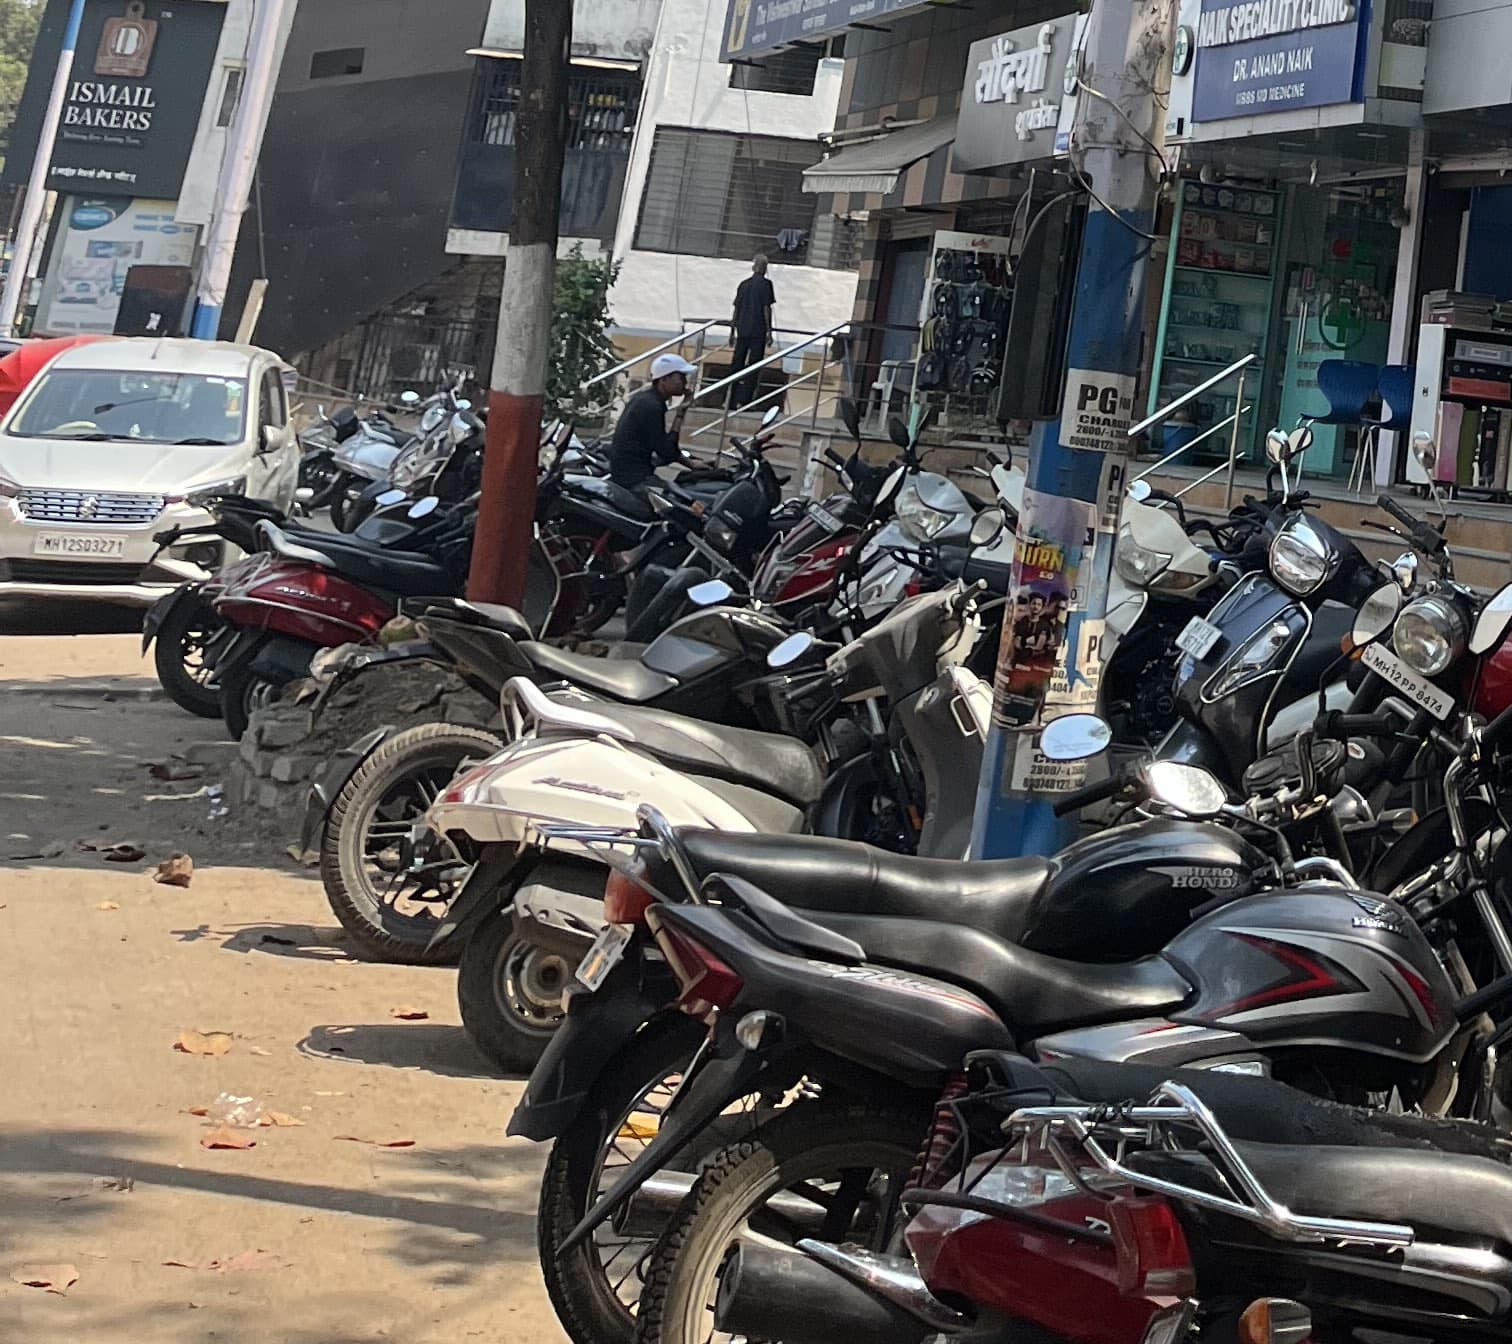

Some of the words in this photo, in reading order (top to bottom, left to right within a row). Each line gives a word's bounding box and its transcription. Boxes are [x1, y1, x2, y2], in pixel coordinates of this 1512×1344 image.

[1199, 9, 1228, 48] NAIK
[1233, 60, 1249, 83] DR.
[1251, 51, 1286, 79] ANAND
[1288, 47, 1314, 72] NAIK
[70, 81, 156, 108] ISMAIL
[1269, 82, 1305, 102] MEDICINE
[64, 106, 151, 131] BAKERS
[1077, 384, 1118, 414] PG
[1187, 866, 1233, 878] HERO
